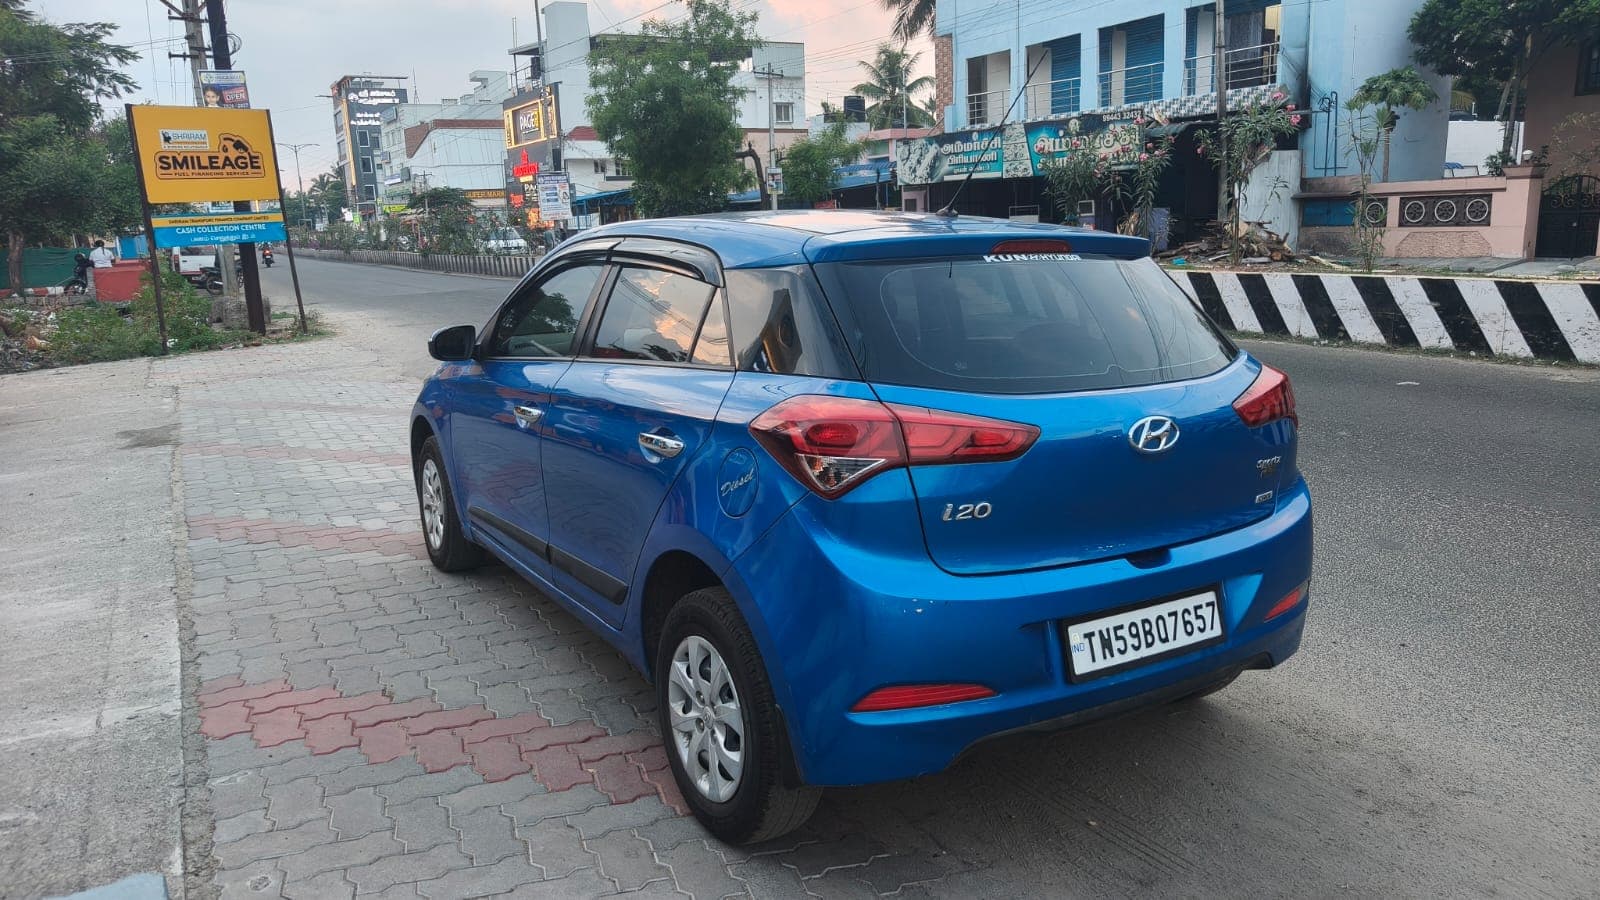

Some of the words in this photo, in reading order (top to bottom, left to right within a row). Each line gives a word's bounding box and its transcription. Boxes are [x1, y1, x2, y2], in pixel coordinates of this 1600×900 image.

[172, 132, 206, 141] SHRIRAM
[158, 155, 261, 171] SMILEAGE
[176, 226, 196, 235] CASH
[196, 224, 240, 234] COLLECTION
[241, 223, 266, 231] CENTRE
[983, 253, 1028, 263] KUN
[720, 467, 754, 497] Diesel
[1083, 600, 1216, 663] TN59BQ7657
